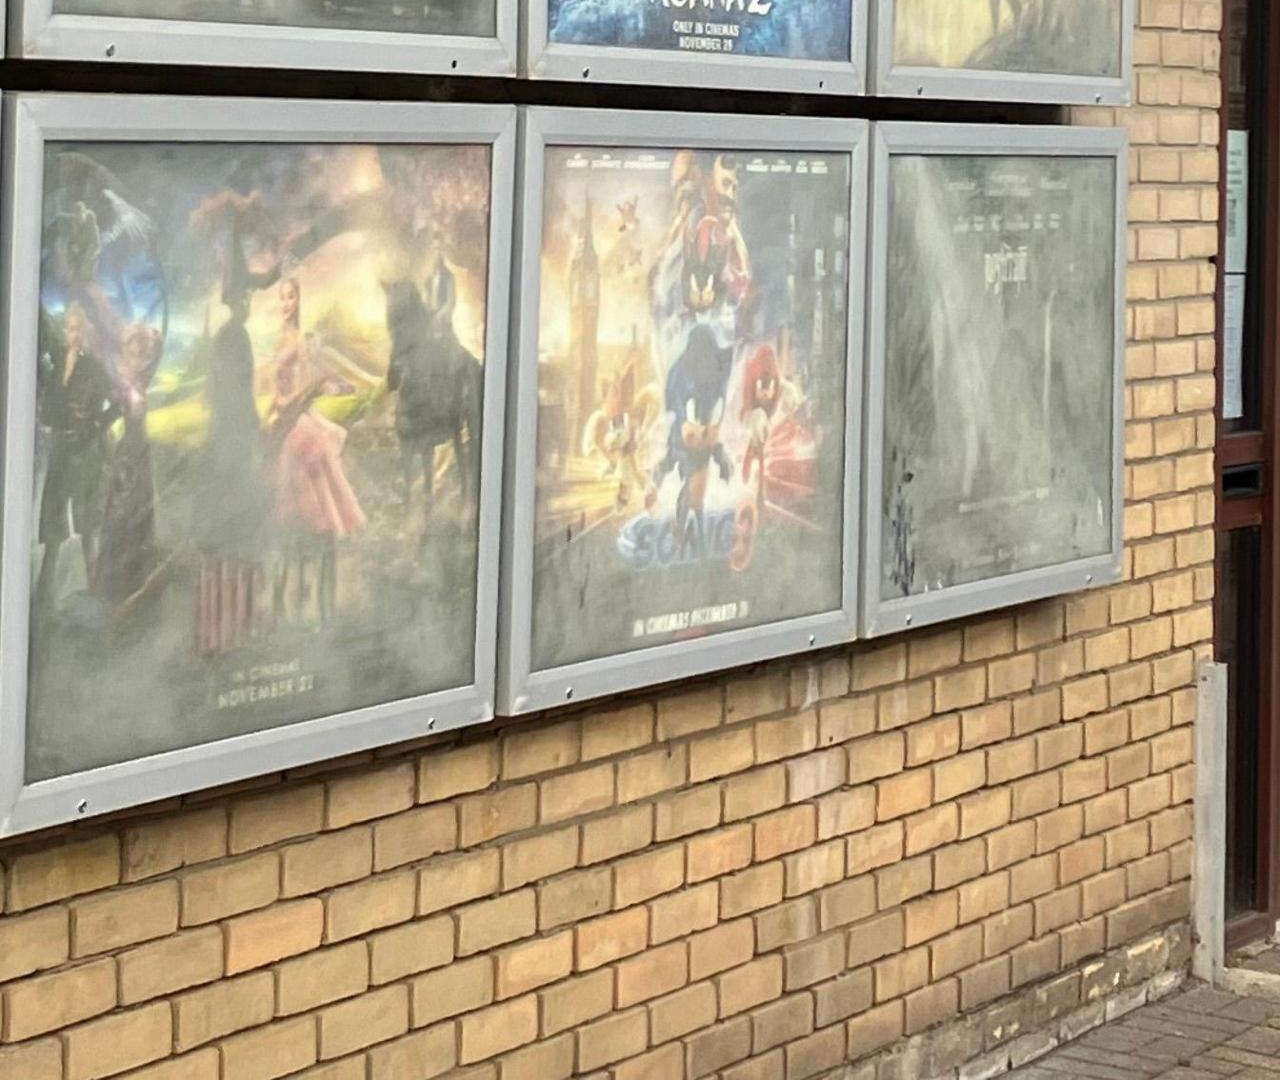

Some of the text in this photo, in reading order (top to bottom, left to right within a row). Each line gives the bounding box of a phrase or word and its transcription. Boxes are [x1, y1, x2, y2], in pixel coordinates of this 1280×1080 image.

[673, 20, 694, 33] ONLY
[705, 23, 740, 36] CINEMAS
[679, 36, 722, 50] NOVEMBER
[218, 679, 293, 709] NOVEMBER
